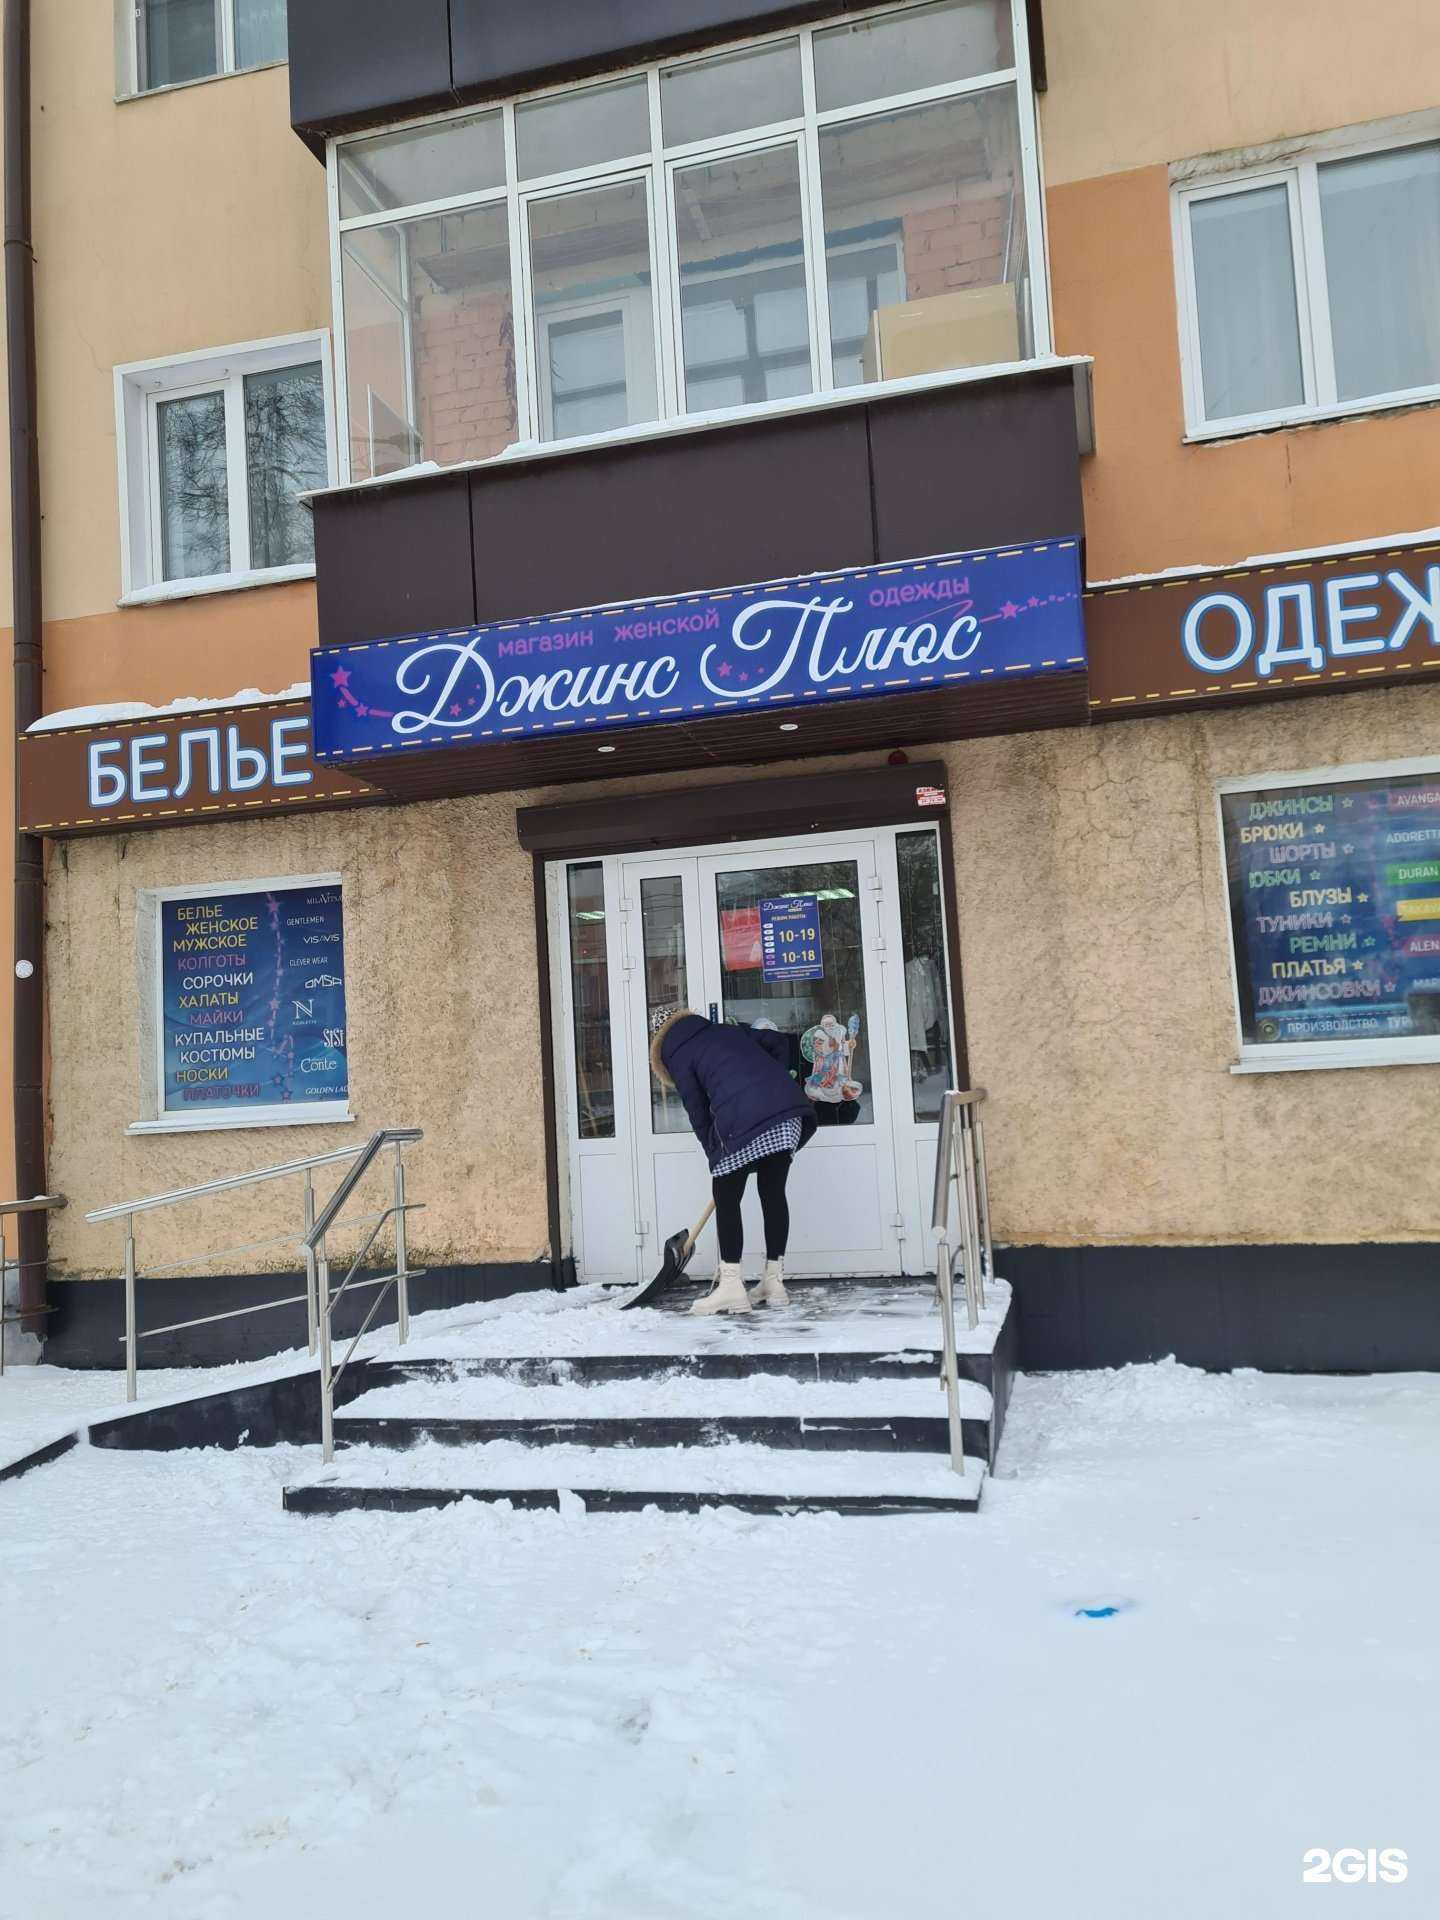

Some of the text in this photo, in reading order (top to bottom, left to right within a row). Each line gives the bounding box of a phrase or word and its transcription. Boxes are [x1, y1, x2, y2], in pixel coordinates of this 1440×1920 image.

[498, 576, 969, 657] магазин женской одежды
[391, 596, 982, 733] Джинс Плюс
[88, 717, 312, 807] БЕЛЬЕ
[1249, 794, 1334, 821] ДЖИНСЫ
[1240, 822, 1304, 843] БРЮКИ
[1270, 842, 1337, 864] ШОРТЫ
[1249, 868, 1301, 889] ЮБКИ
[1289, 887, 1353, 908] БЛУЗЫ
[177, 904, 223, 921] БЕЛЬЕ
[287, 915, 325, 926] GENTLEMEN
[1256, 911, 1333, 933] ТУНИКИ
[185, 916, 259, 936] ЖЕНСКОЕ
[778, 928, 815, 943] 10-19
[173, 934, 248, 953] МУЖСКОЕ
[1289, 932, 1356, 954] РЕМНИ
[177, 953, 246, 971] КОЛГОТЫ
[312, 956, 328, 965] WEAR
[782, 950, 815, 964] 10-18
[1271, 957, 1346, 979] ПЛАТЬЯ
[182, 971, 254, 990] СОРОЧКИ
[178, 991, 239, 1009] ХАЛАТЫ
[1258, 979, 1381, 1006] ДЖИНСОВКИ
[189, 1009, 244, 1025] МАЙКИ
[1287, 1017, 1378, 1034] ПРОИЗВОДСТВО
[175, 1027, 265, 1047] КУПАЛЬНЫЕ
[180, 1046, 256, 1064] КОСТЮМЫ
[176, 1066, 229, 1083] НОСКИ
[300, 1057, 337, 1073] Conte
